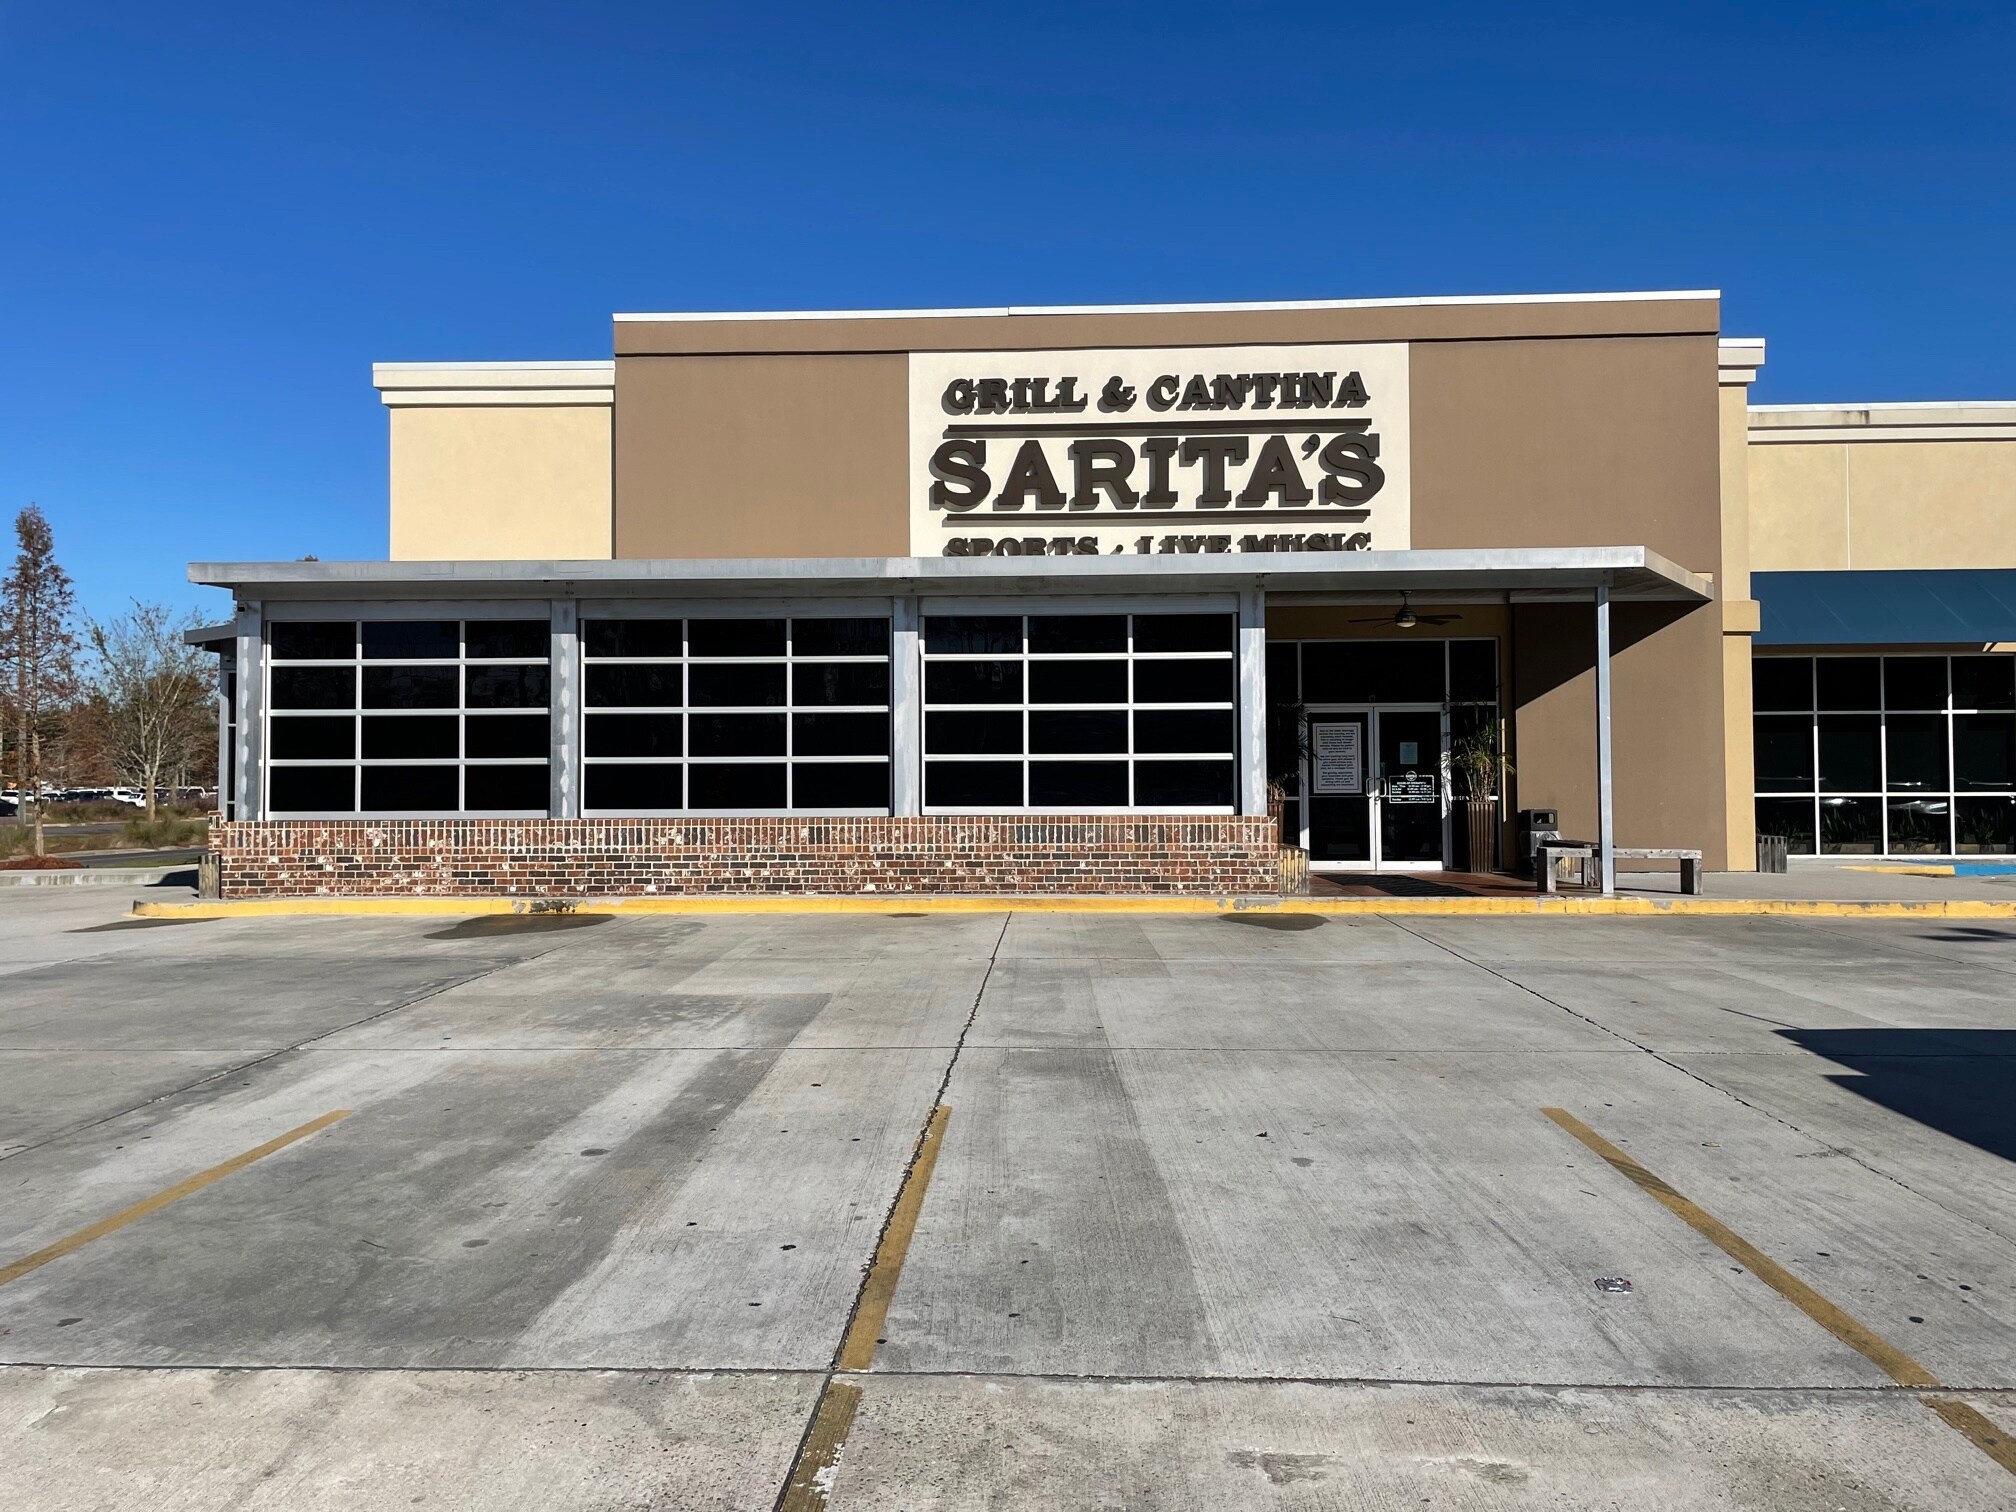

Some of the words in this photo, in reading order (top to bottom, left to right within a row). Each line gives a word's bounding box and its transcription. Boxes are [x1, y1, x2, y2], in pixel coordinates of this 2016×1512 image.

[946, 376, 1088, 411] GRILL
[1103, 375, 1137, 408] &
[1151, 371, 1371, 409] CANTINA
[932, 432, 1386, 510] SARITA'S
